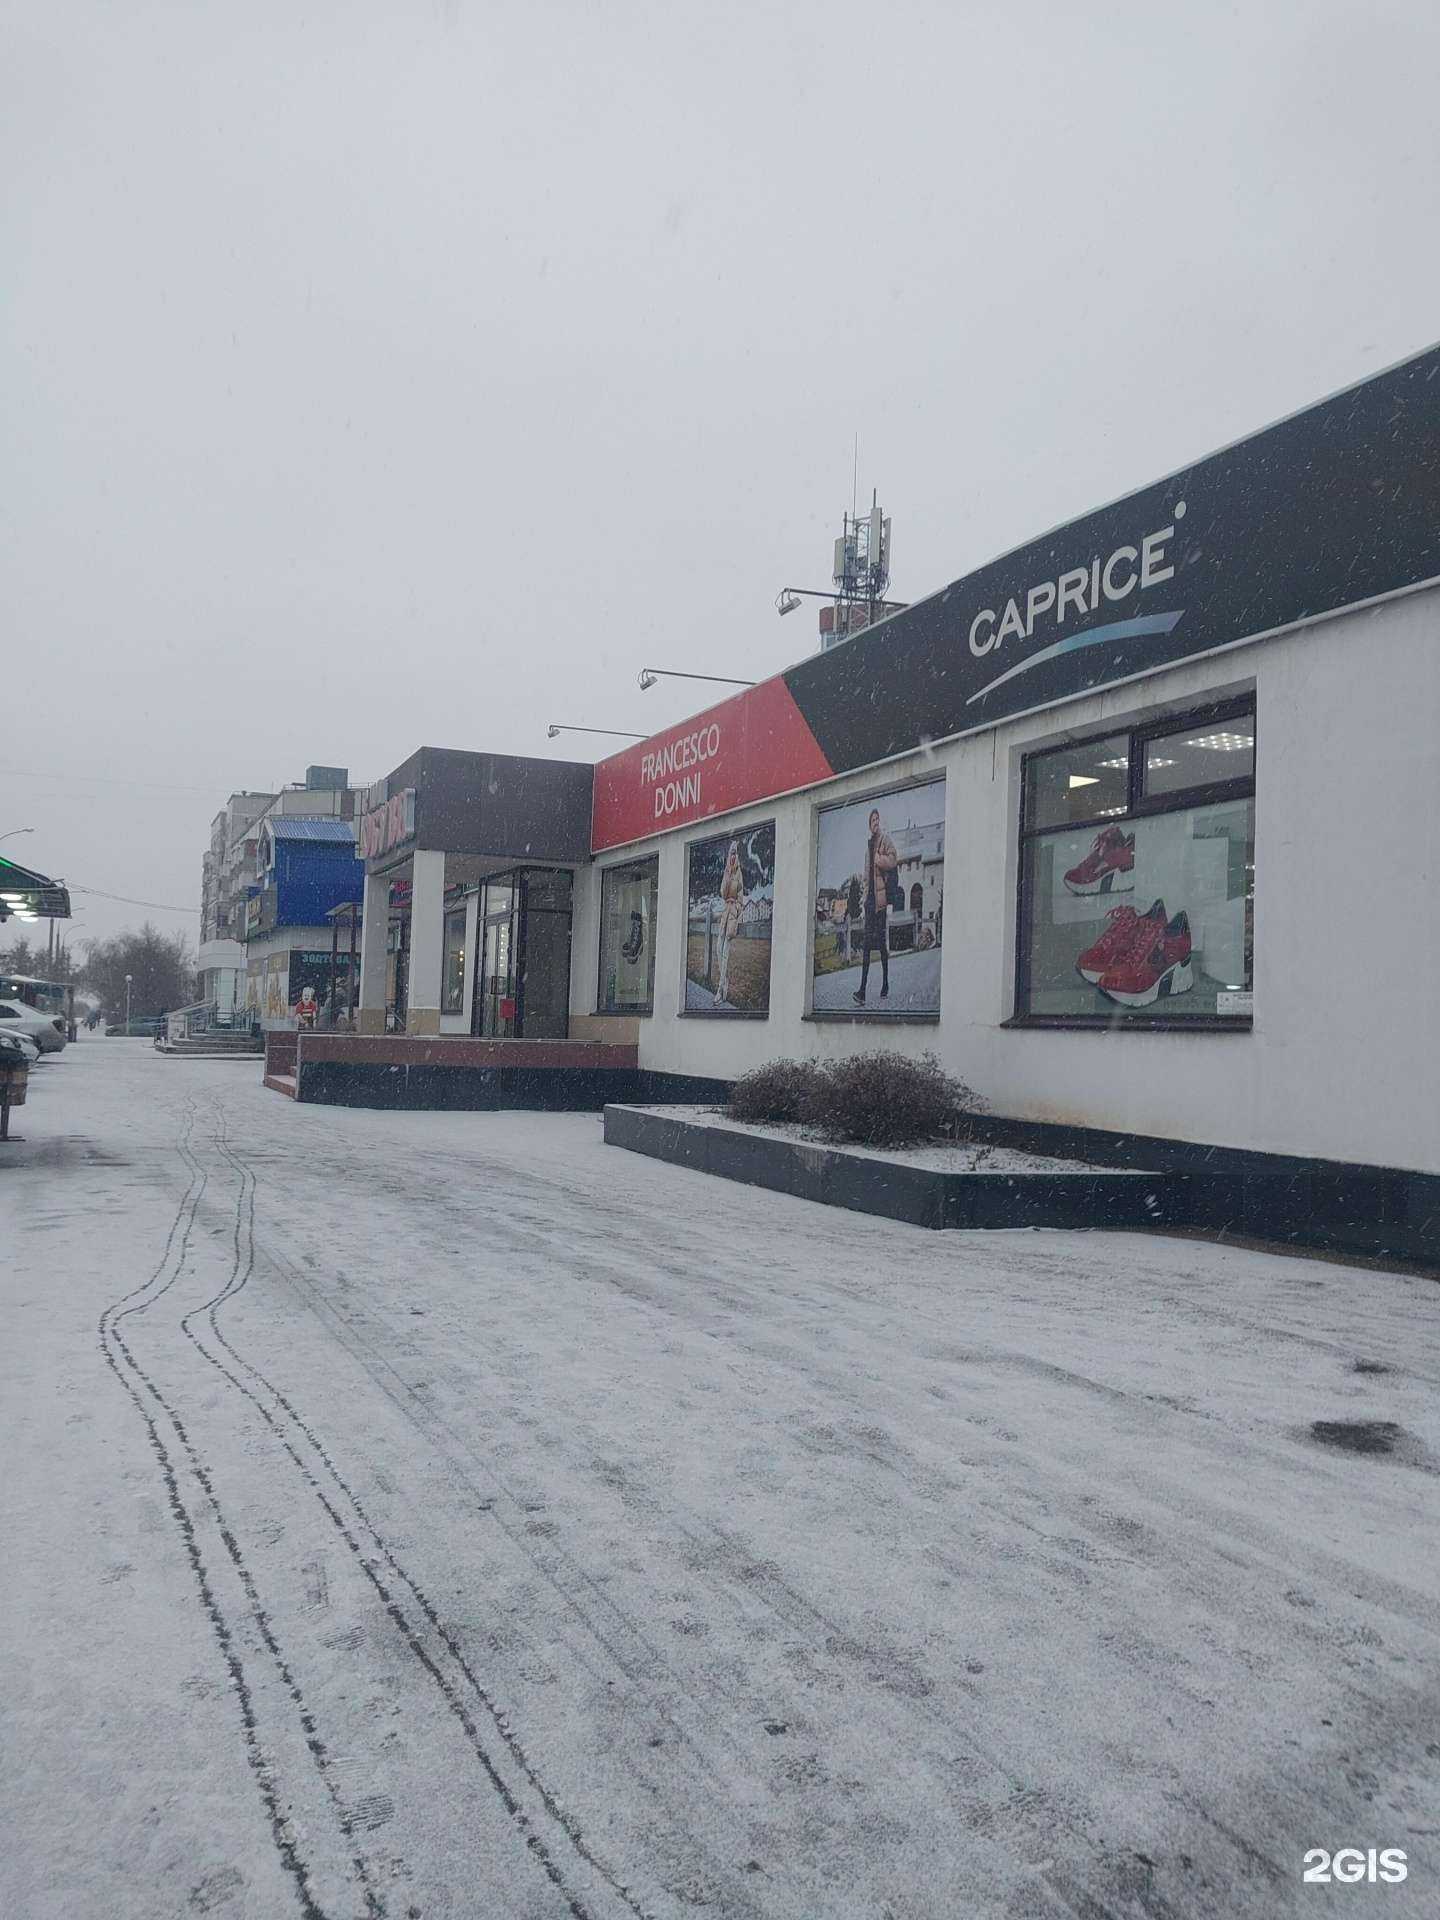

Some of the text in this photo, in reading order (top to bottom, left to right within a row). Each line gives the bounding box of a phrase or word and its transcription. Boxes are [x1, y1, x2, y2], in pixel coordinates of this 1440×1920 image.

[969, 525, 1175, 657] CAPRICE
[641, 723, 720, 785] FRANCESCO
[654, 771, 701, 818] DONNI
